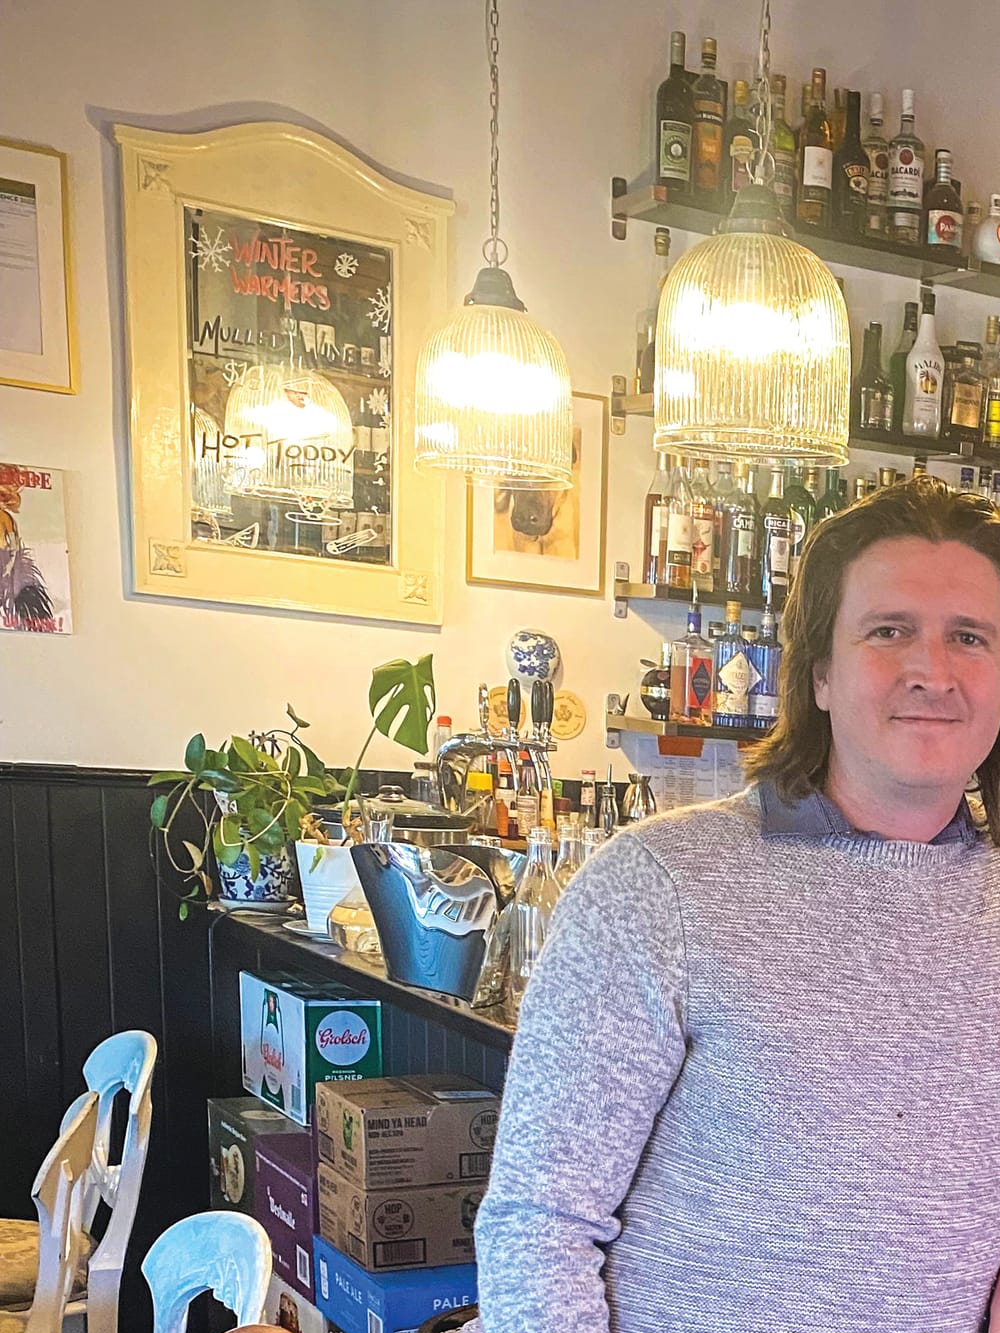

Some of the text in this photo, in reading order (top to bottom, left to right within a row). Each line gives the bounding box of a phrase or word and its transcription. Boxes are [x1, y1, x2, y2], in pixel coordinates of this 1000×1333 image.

[230, 228, 322, 278] WINTER
[230, 265, 332, 311] WARMERS
[201, 430, 357, 469] HOT TODDY
[318, 1028, 368, 1049] Grolsch
[367, 1116, 428, 1131] MIND YA HEAD
[384, 1203, 402, 1214] HOP
[335, 1272, 350, 1295] PALE
[350, 1288, 363, 1305] ALE
[432, 1295, 470, 1311] PALE
